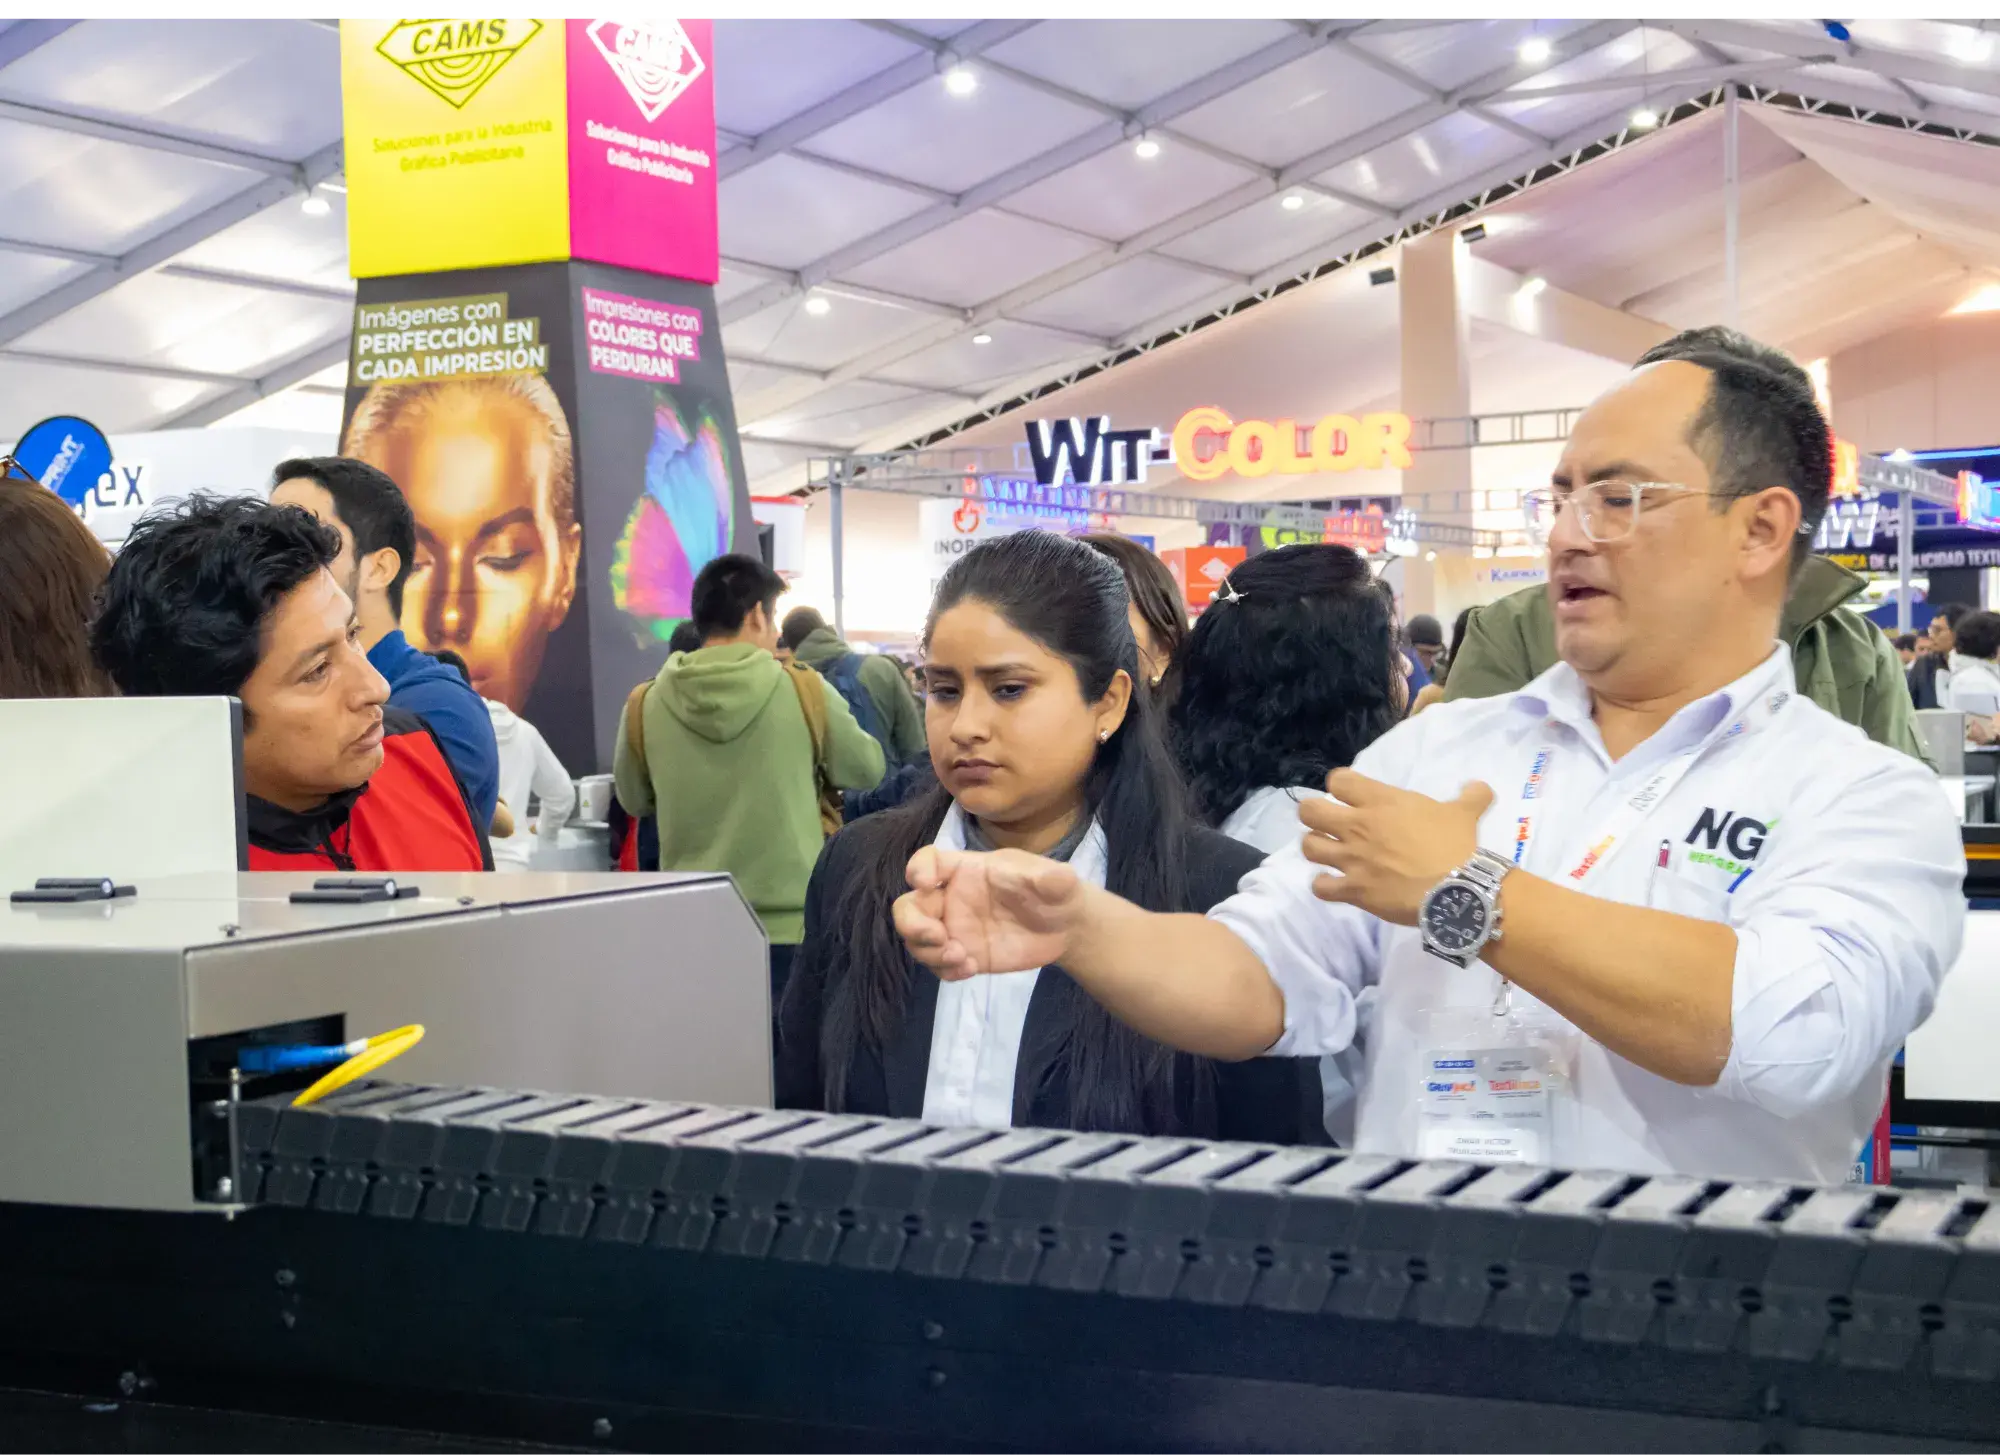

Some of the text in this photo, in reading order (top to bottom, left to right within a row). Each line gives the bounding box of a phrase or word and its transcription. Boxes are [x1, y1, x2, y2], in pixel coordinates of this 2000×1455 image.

[413, 17, 507, 55] CAMS
[445, 130, 473, 147] para
[359, 301, 501, 331] Imágenes con
[585, 291, 700, 332] Impresiones con
[357, 320, 534, 356] PERFECCIÓN EN
[588, 318, 696, 357] COLORES QUE
[356, 343, 547, 381] CADA IMPRESIÓN
[590, 344, 675, 379] PERDURAN
[1685, 806, 1768, 861] NG
